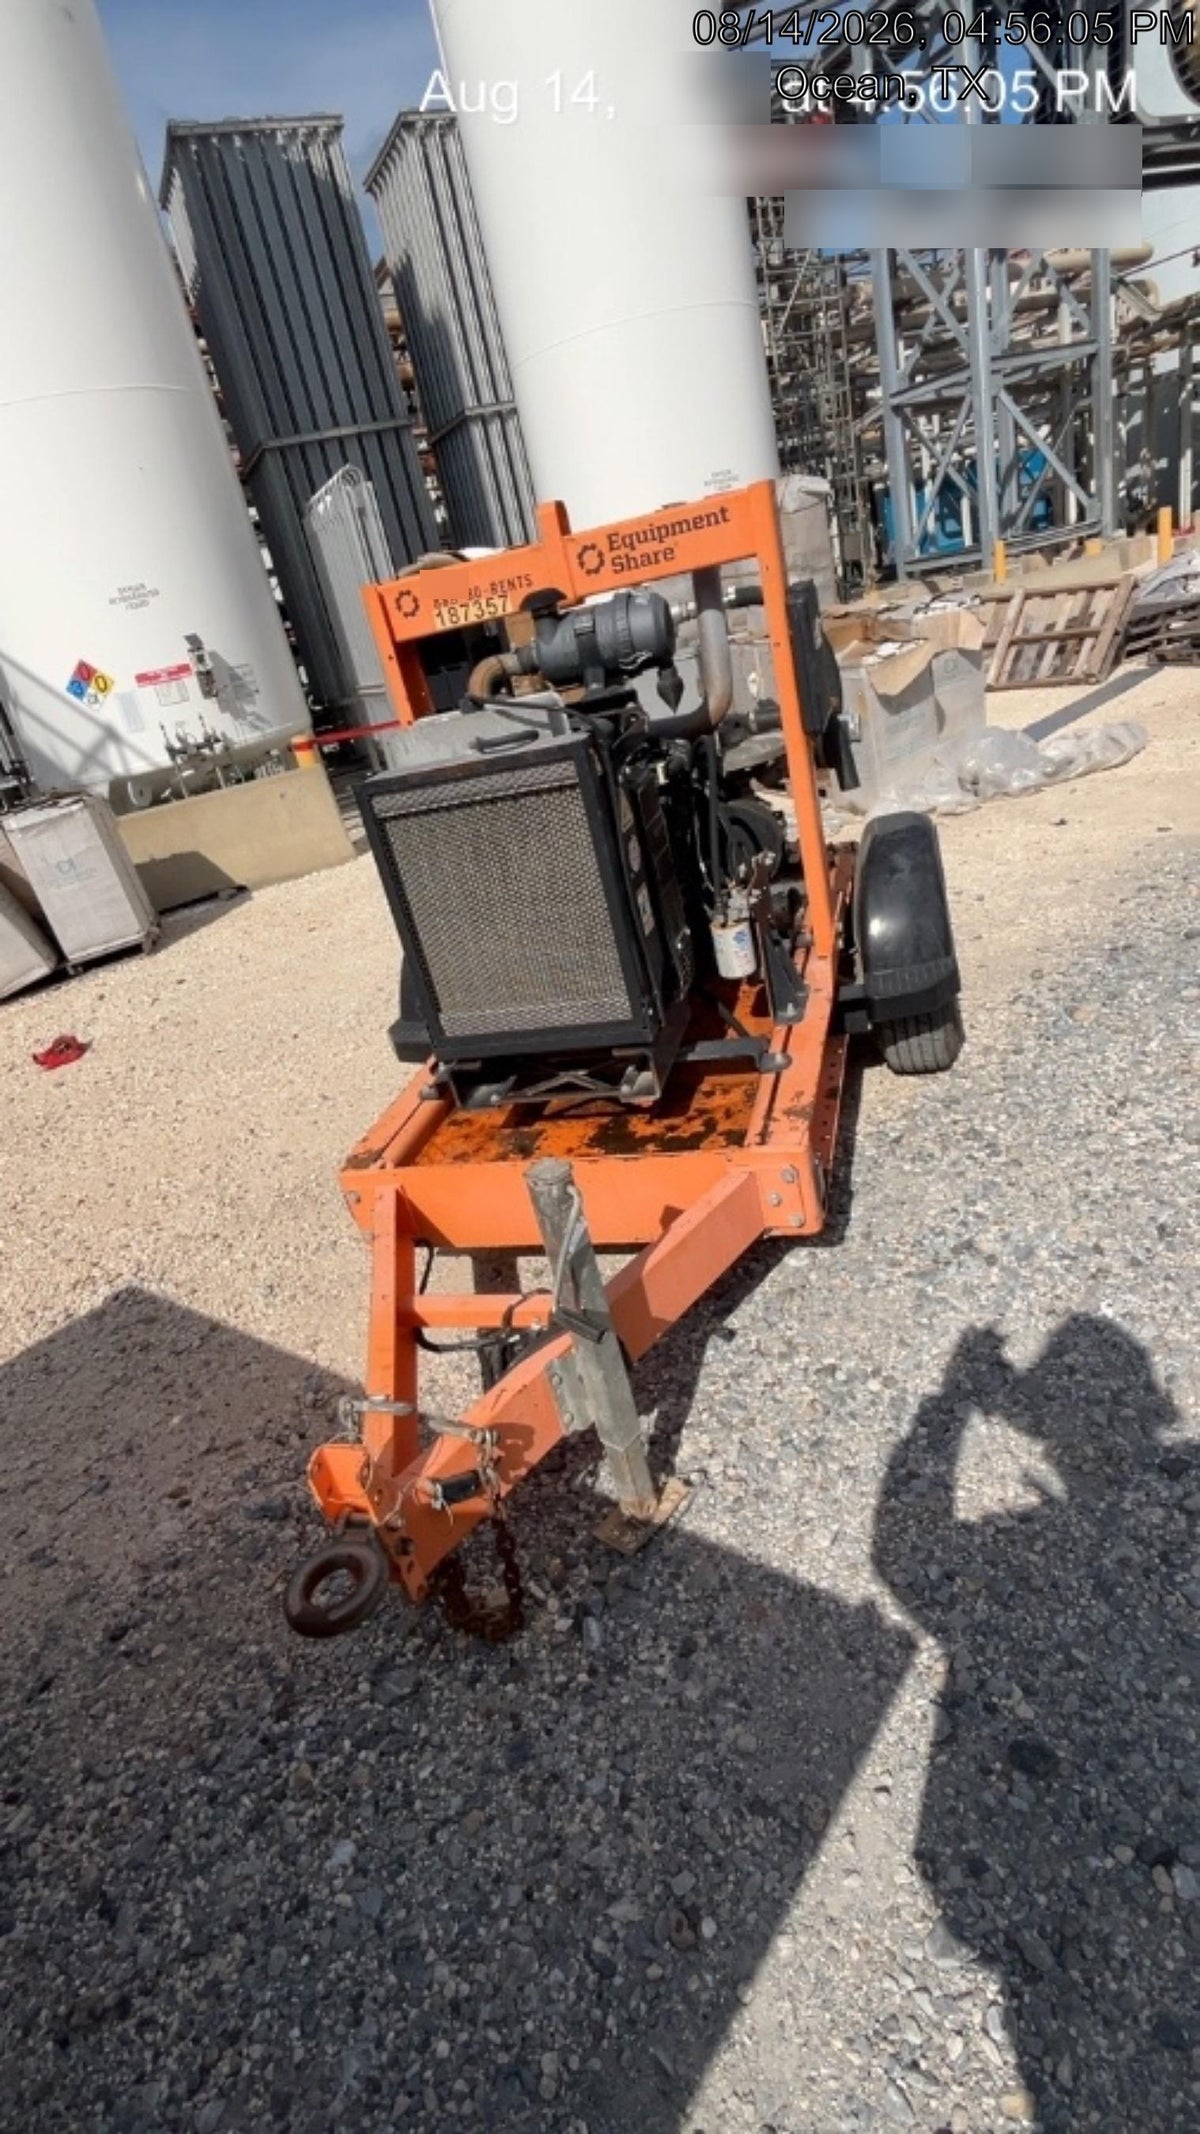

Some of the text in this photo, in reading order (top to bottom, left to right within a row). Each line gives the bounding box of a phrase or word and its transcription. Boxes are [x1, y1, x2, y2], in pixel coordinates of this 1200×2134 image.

[607, 505, 730, 551] Equipment
[611, 546, 676, 575] Share
[435, 595, 509, 627] 187357
